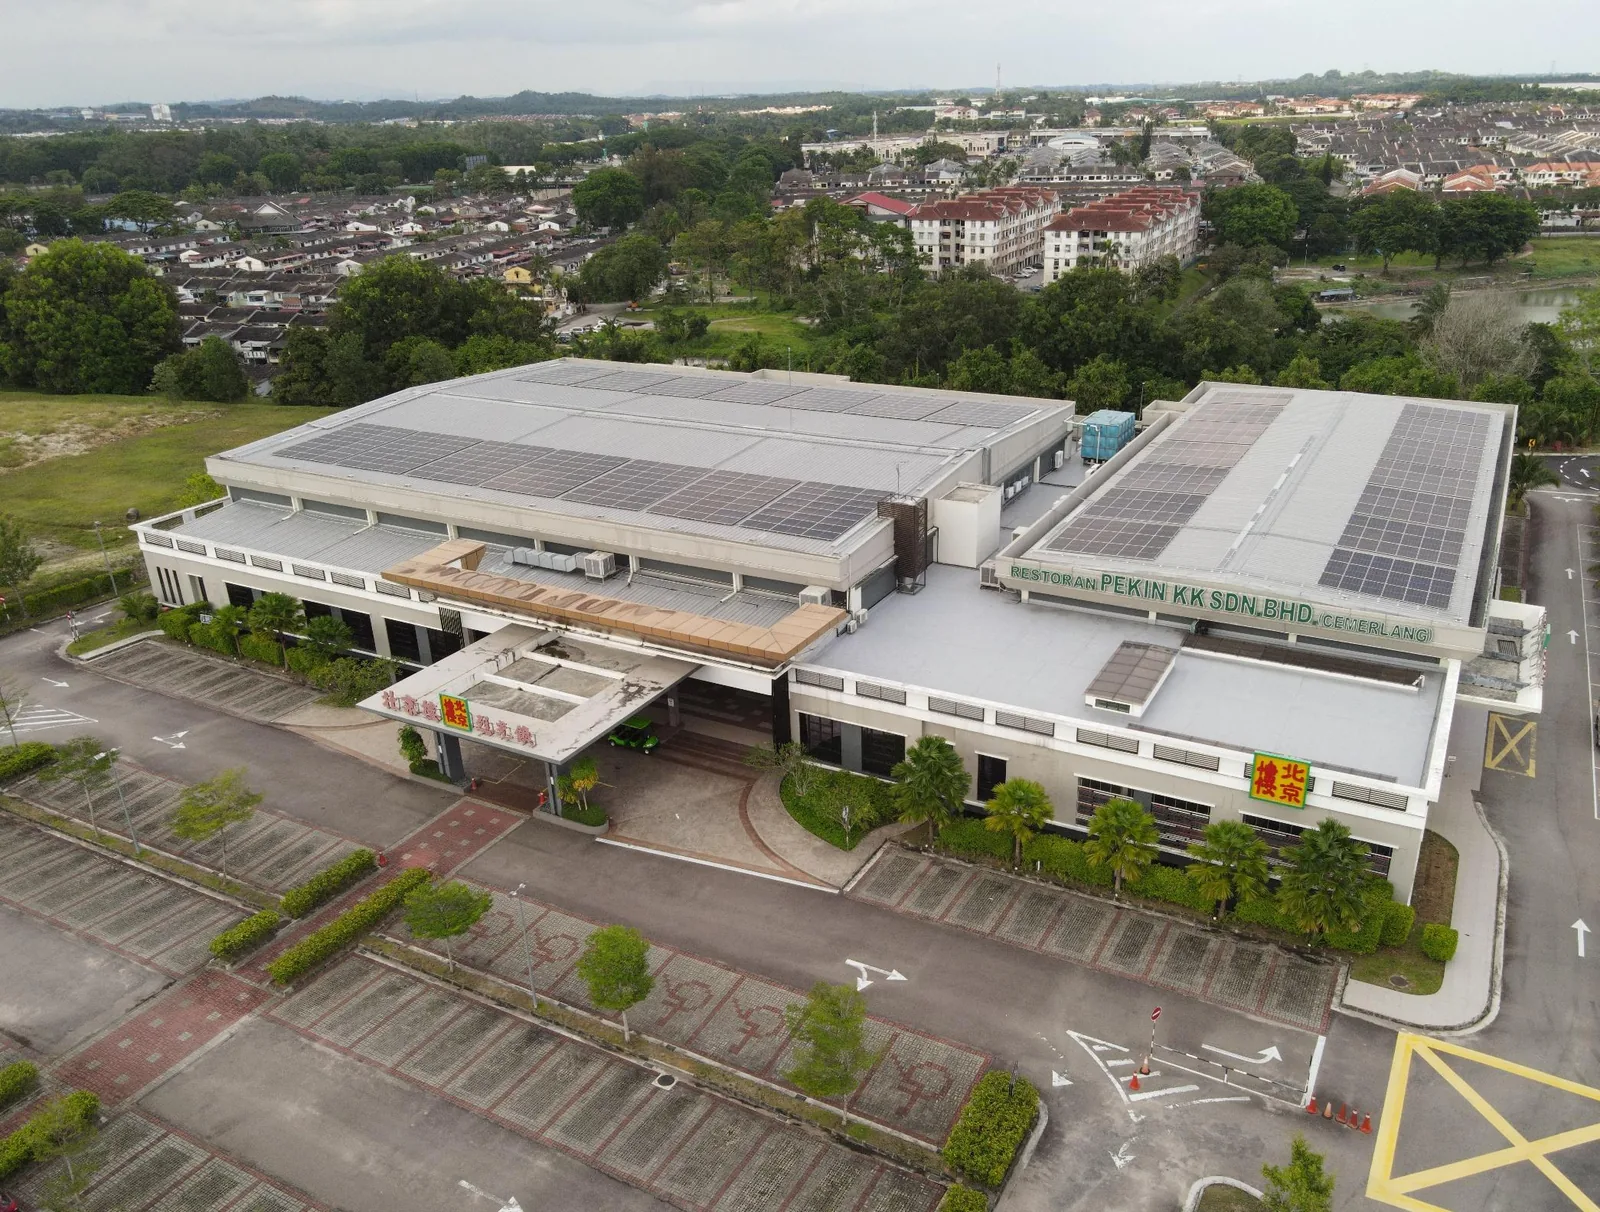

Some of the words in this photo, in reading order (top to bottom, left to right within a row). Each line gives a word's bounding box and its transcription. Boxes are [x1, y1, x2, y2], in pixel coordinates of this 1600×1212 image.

[1010, 565, 1096, 590] RESTORAN
[1100, 573, 1167, 601] PEKIN
[1173, 584, 1205, 608] KK
[1317, 613, 1433, 643] (CEMERLANG)
